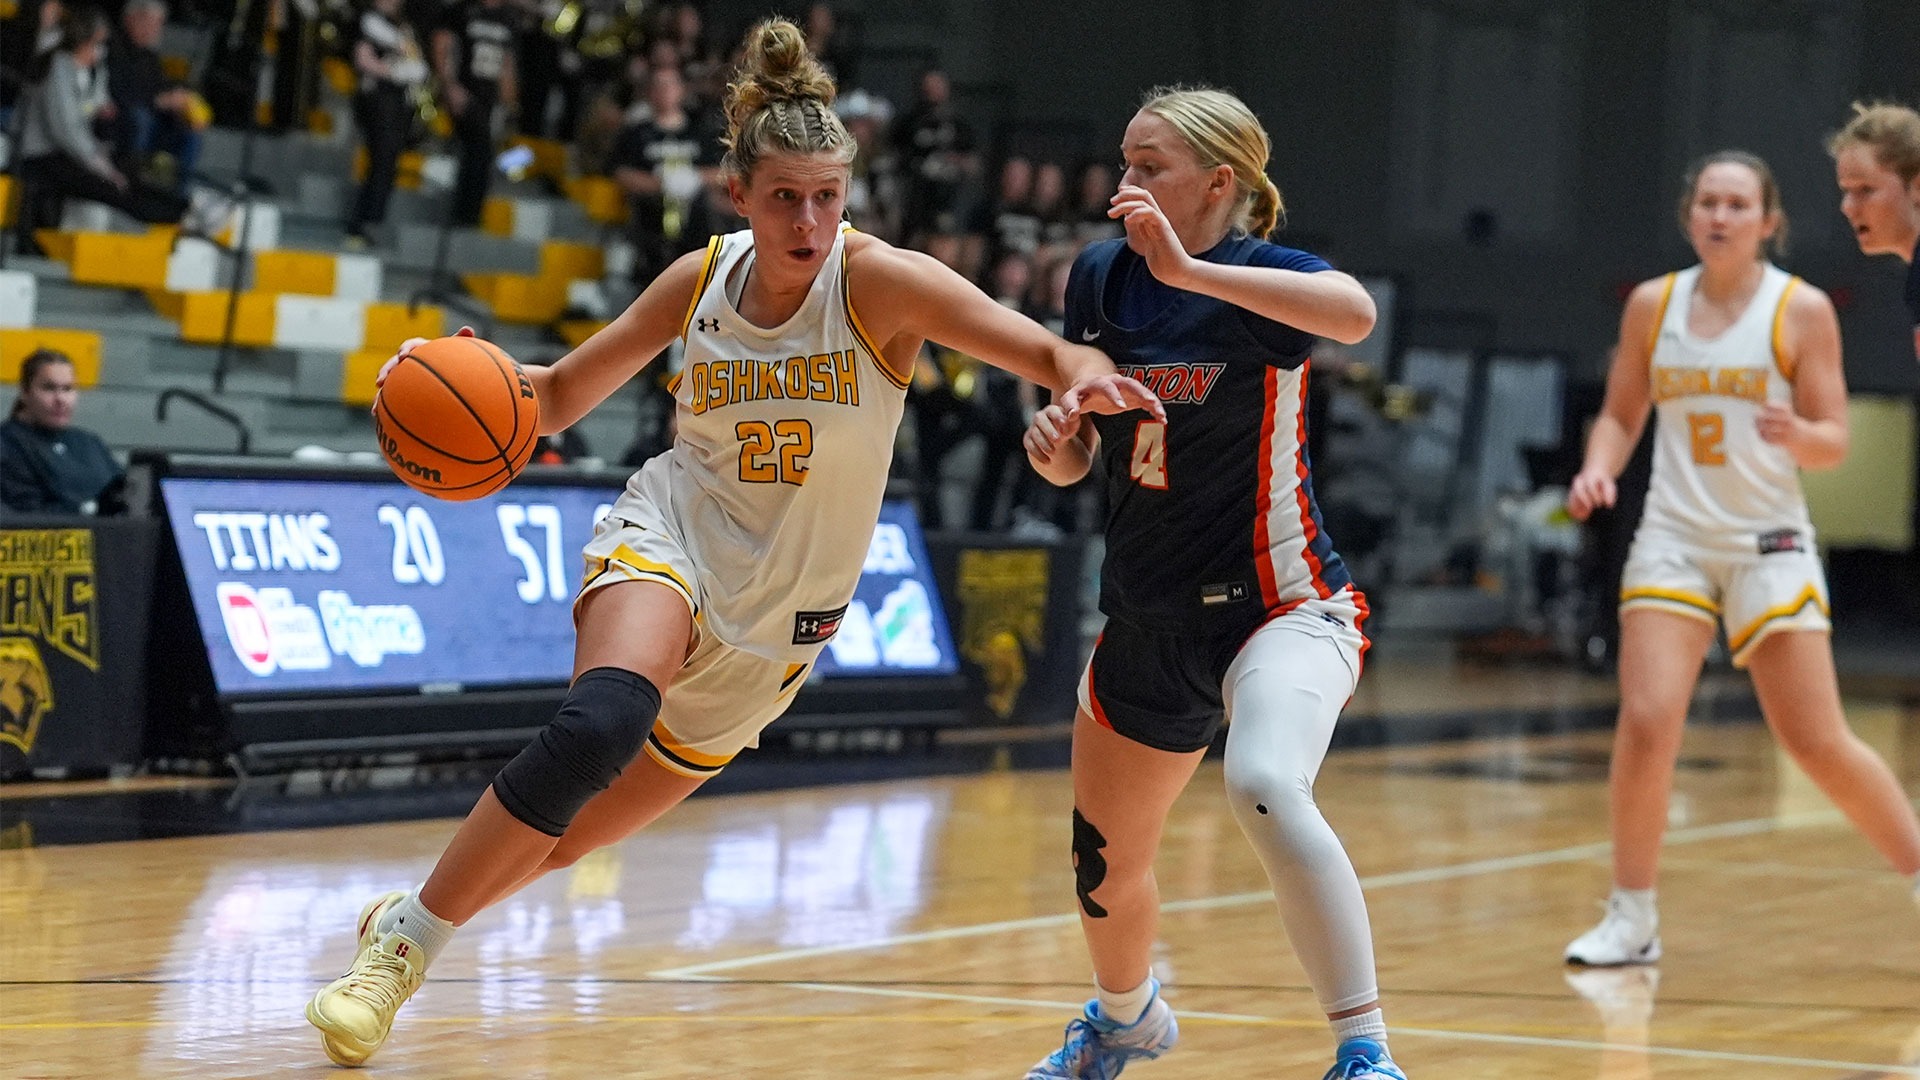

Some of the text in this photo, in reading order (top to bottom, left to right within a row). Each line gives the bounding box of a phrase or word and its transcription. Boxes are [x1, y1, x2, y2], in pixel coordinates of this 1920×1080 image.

[692, 349, 859, 416] OSHKOSH
[735, 418, 813, 487] 22
[1130, 419, 1168, 490] 4
[193, 511, 341, 571] TITANS
[377, 505, 445, 584] 20
[496, 504, 569, 603] 57
[1233, 587, 1243, 597] M
